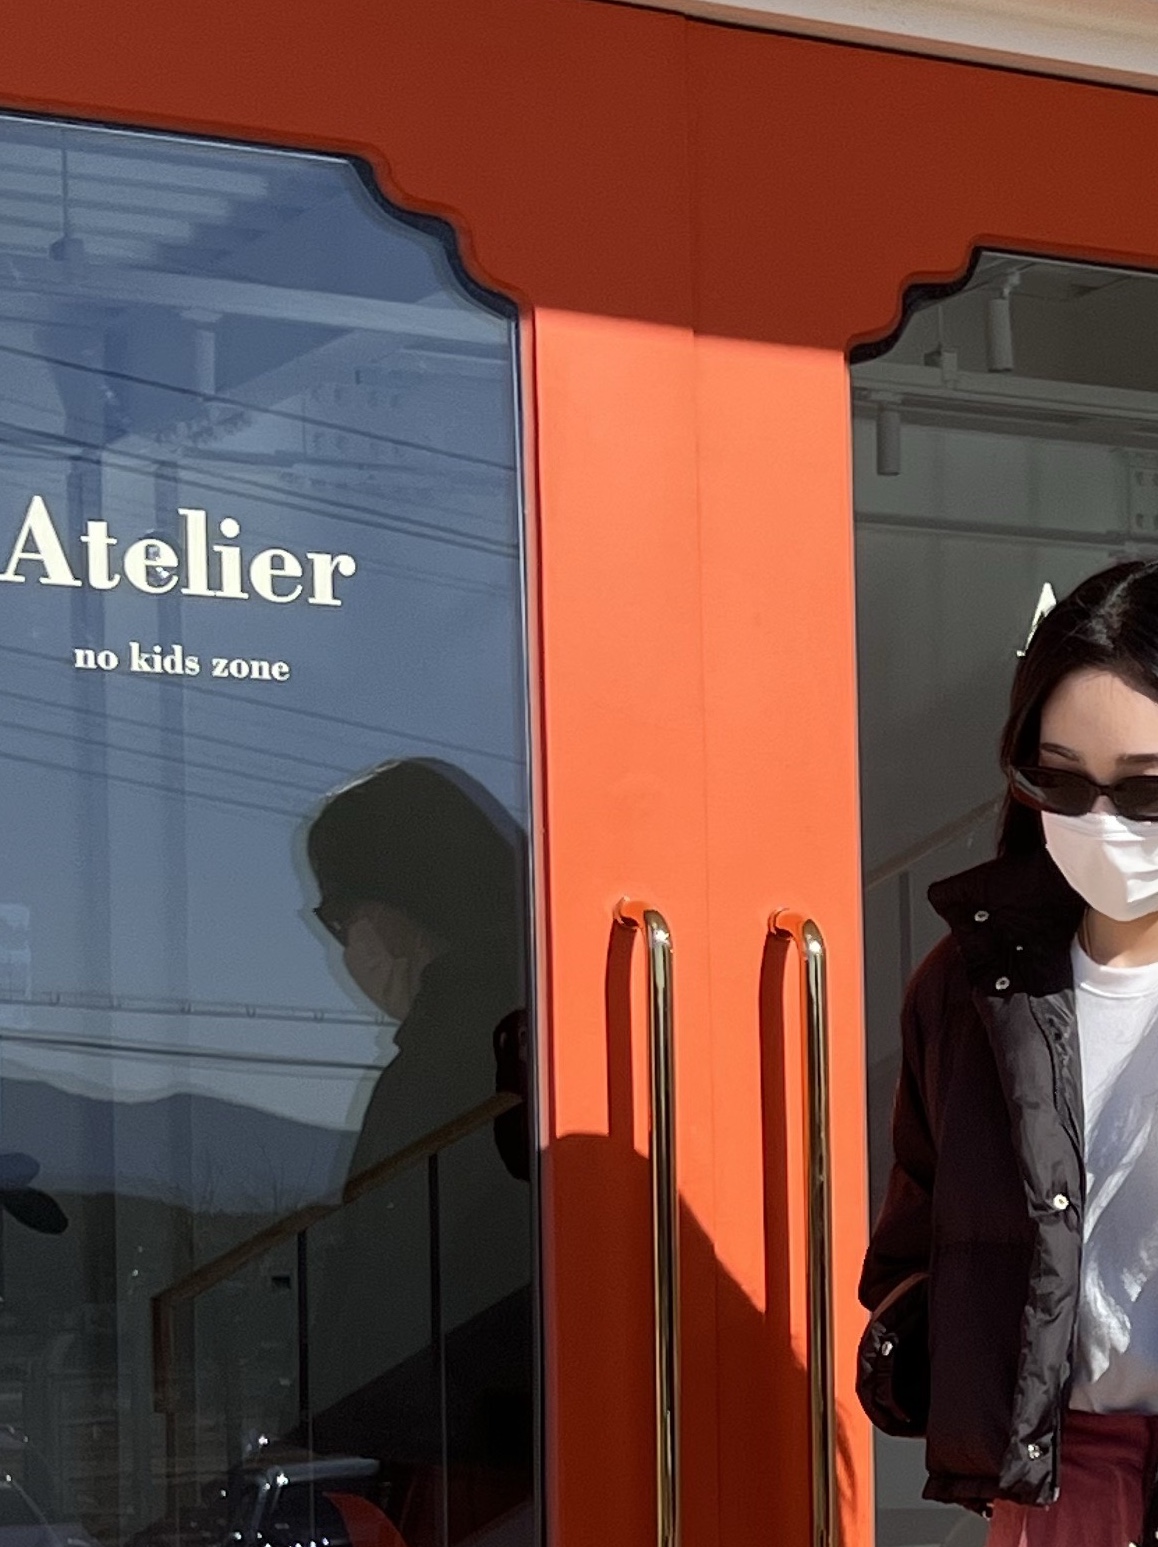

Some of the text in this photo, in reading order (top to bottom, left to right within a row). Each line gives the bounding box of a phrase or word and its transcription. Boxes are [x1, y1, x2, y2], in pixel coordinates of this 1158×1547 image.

[0, 495, 356, 606] Atelier
[74, 641, 291, 681] no kids zone
